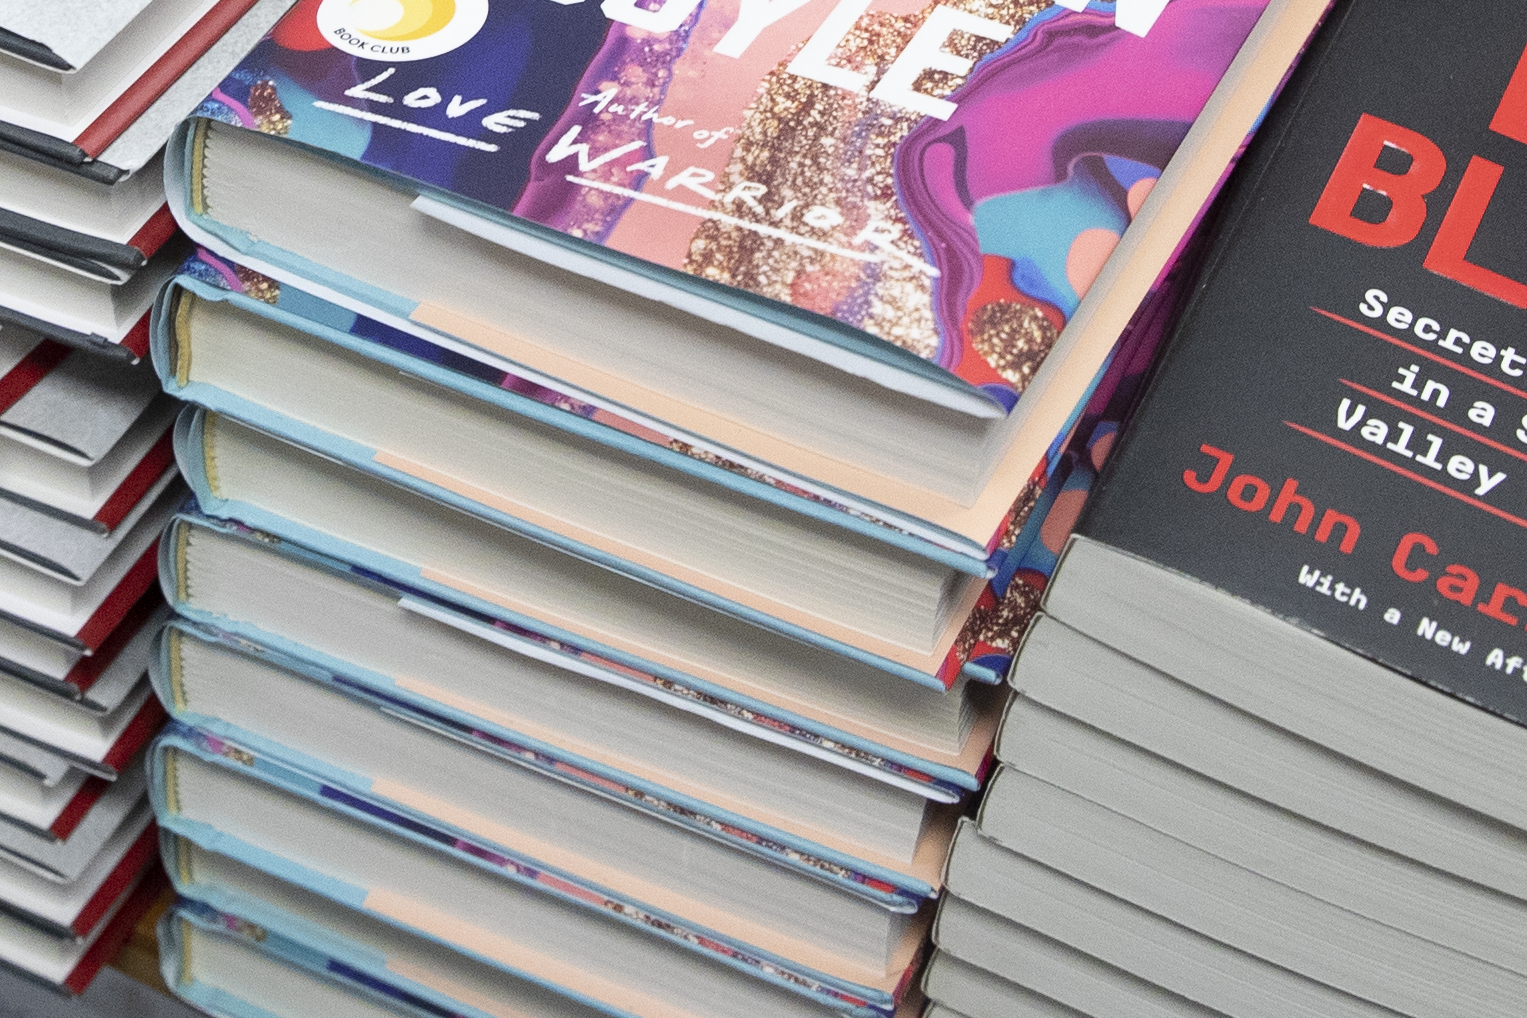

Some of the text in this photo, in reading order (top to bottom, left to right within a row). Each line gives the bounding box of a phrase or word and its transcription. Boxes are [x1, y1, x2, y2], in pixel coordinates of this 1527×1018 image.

[333, 26, 411, 55] BOOK CLUB
[343, 66, 542, 134] LOVE
[578, 85, 736, 150] Author of
[543, 123, 924, 254] WARRIOR
[1358, 287, 1527, 378] Secret
[1391, 363, 1450, 409] in
[1467, 400, 1496, 428] a
[1335, 398, 1508, 497] Valley
[1182, 443, 1527, 634] John Car
[1296, 564, 1527, 683] With a New Af
